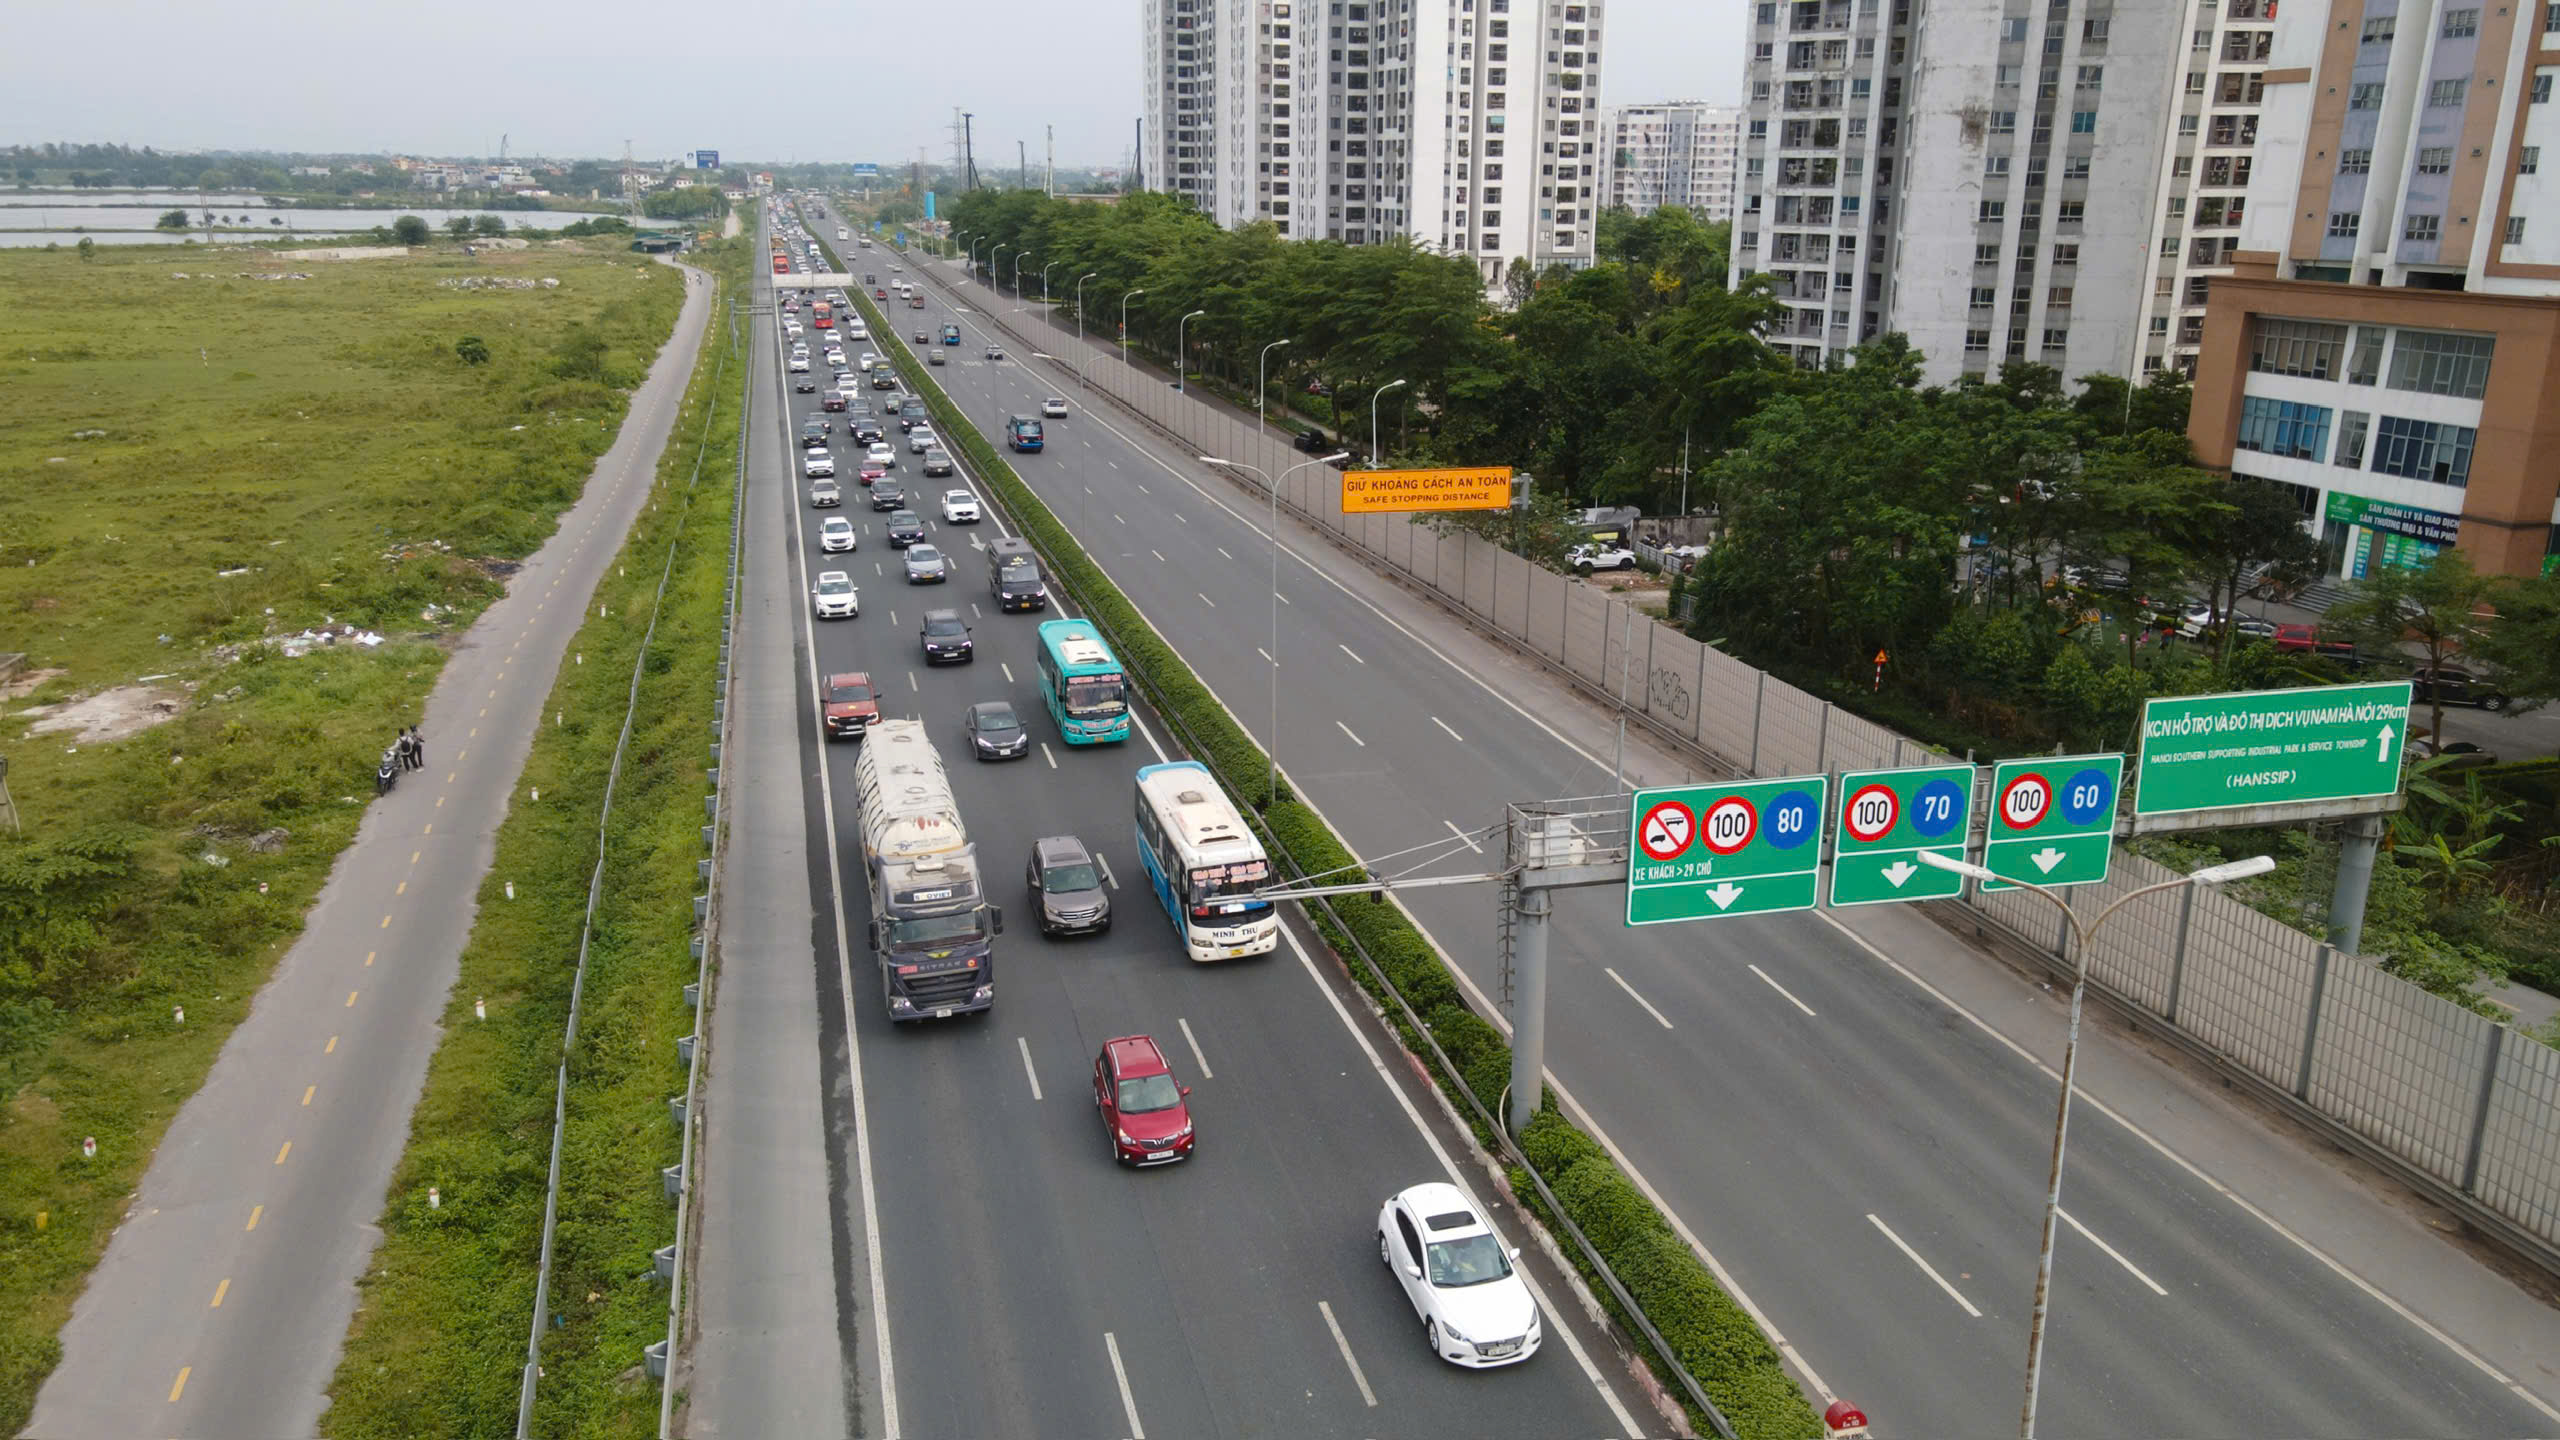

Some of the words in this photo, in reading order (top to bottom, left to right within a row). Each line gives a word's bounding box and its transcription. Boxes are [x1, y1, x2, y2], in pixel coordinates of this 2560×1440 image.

[1347, 477, 1367, 491] GIỮ
[1371, 476, 1418, 490] KHOẢNG
[1422, 475, 1453, 489] CÁCH
[1458, 478, 1473, 487] AN
[1478, 473, 1506, 486] TOÀN
[1392, 494, 1439, 503] STOPPING
[1443, 492, 1489, 501] DISTANCE
[2424, 514, 2441, 525] GIAO
[2442, 517, 2460, 529] DỊCH
[2146, 720, 2171, 738] KCN
[2172, 712, 2191, 736] HỖ
[2192, 715, 2213, 735] TRỢ
[2214, 711, 2228, 732] VÀ
[2229, 710, 2248, 731] ĐÔ
[2249, 712, 2265, 731] THỊ
[2265, 711, 2293, 730] DỊCH
[2295, 709, 2311, 728] VỤ
[2311, 707, 2338, 725] NAM
[2339, 702, 2355, 723] HÀ
[2355, 701, 2376, 723] NỘI
[2151, 753, 2172, 763] HANOI
[2173, 751, 2206, 762] SOUTHERN
[2208, 748, 2246, 759] SUPPORTING
[2248, 744, 2281, 756] INDUSTRIAL
[2284, 744, 2300, 753] PARK
[2301, 743, 2306, 753] &
[2308, 741, 2333, 752] SERVICE
[2336, 738, 2368, 750] TOWNSHIP
[2012, 789, 2042, 813] 100
[2073, 785, 2099, 809] 60
[1857, 800, 1888, 826] 100
[1924, 795, 1950, 822] 70
[1714, 813, 1746, 839] 100
[1777, 807, 1803, 833] 80
[1635, 868, 1646, 881] XE
[1649, 863, 1675, 879] KHÁCH
[1212, 930, 1235, 938] MINH
